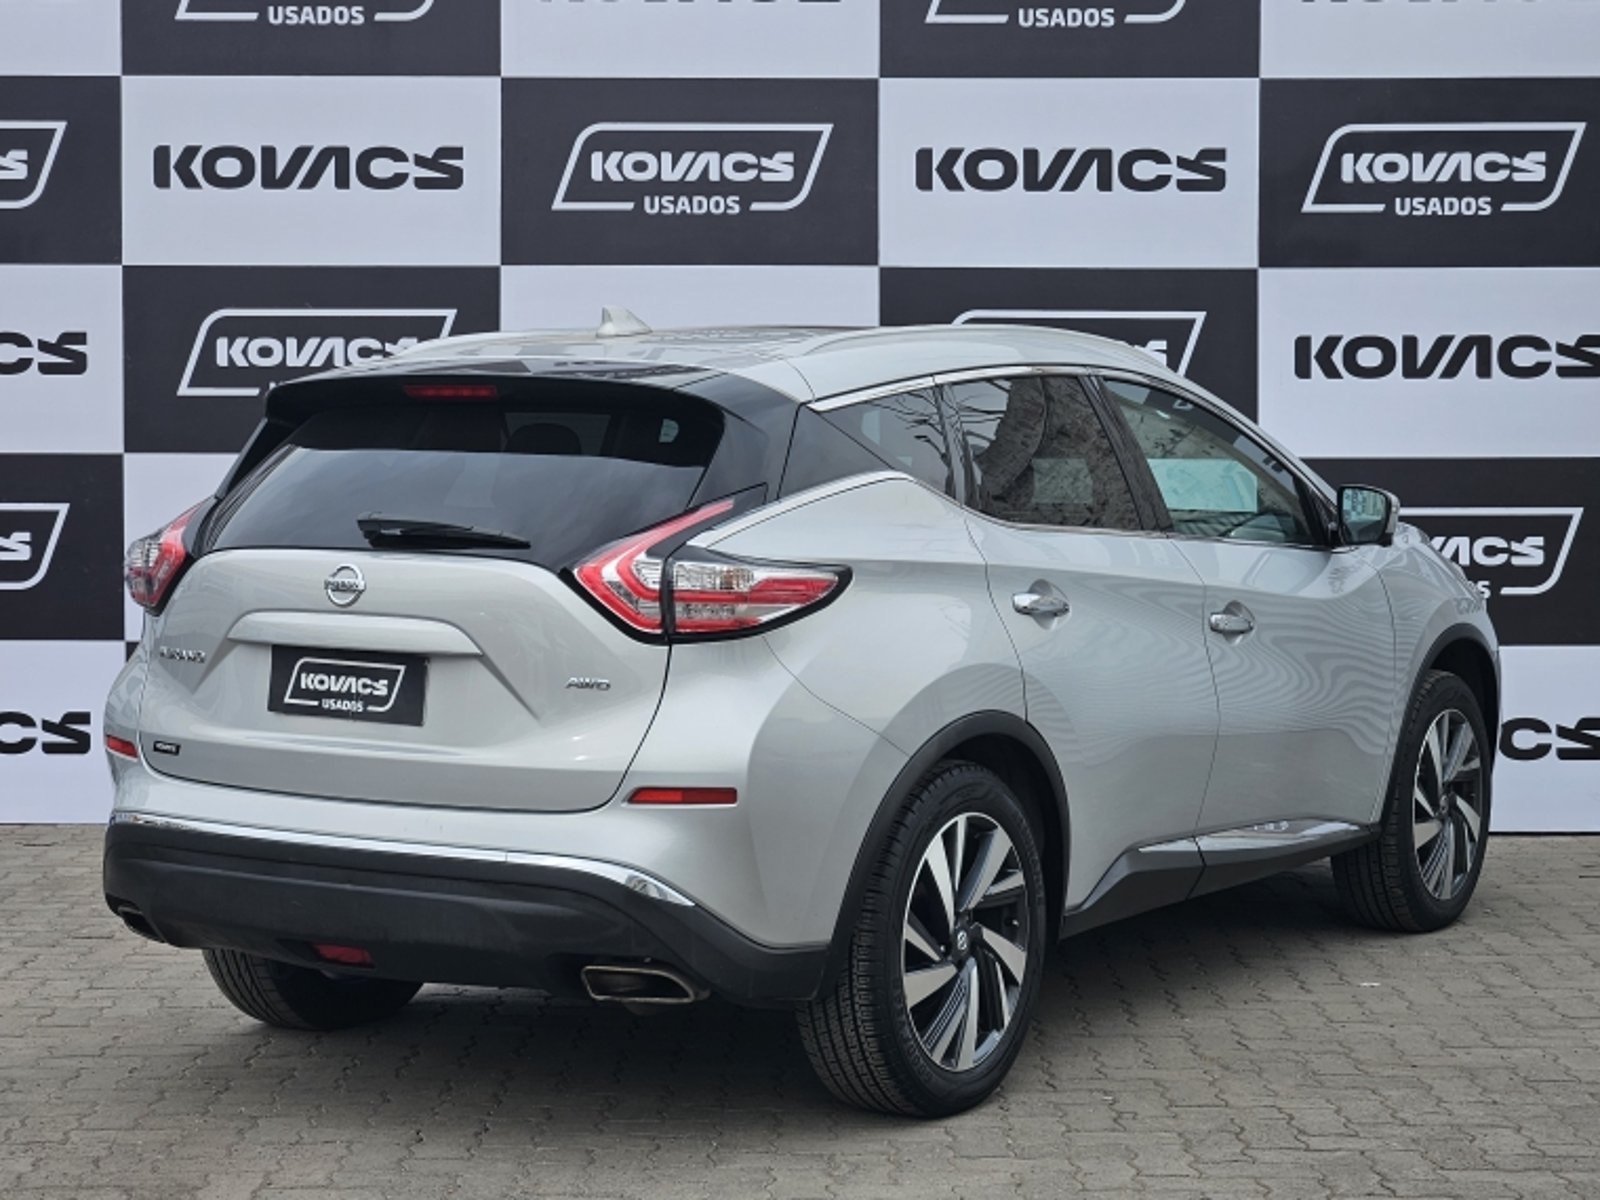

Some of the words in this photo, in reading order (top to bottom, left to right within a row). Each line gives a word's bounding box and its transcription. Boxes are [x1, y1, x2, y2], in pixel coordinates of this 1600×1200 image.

[267, 5, 365, 26] USADOS
[1018, 7, 1115, 28] USADOS
[153, 144, 464, 190] KOVACS
[590, 151, 795, 182] KOVACS
[915, 147, 1227, 193] KOVACS
[1340, 151, 1546, 183] KOVACS
[643, 195, 741, 215] USADOS
[1394, 196, 1492, 216] USADOS
[1294, 334, 1600, 380] KOVACS
[300, 672, 389, 696] KOVACS
[321, 698, 364, 713] USADOS
